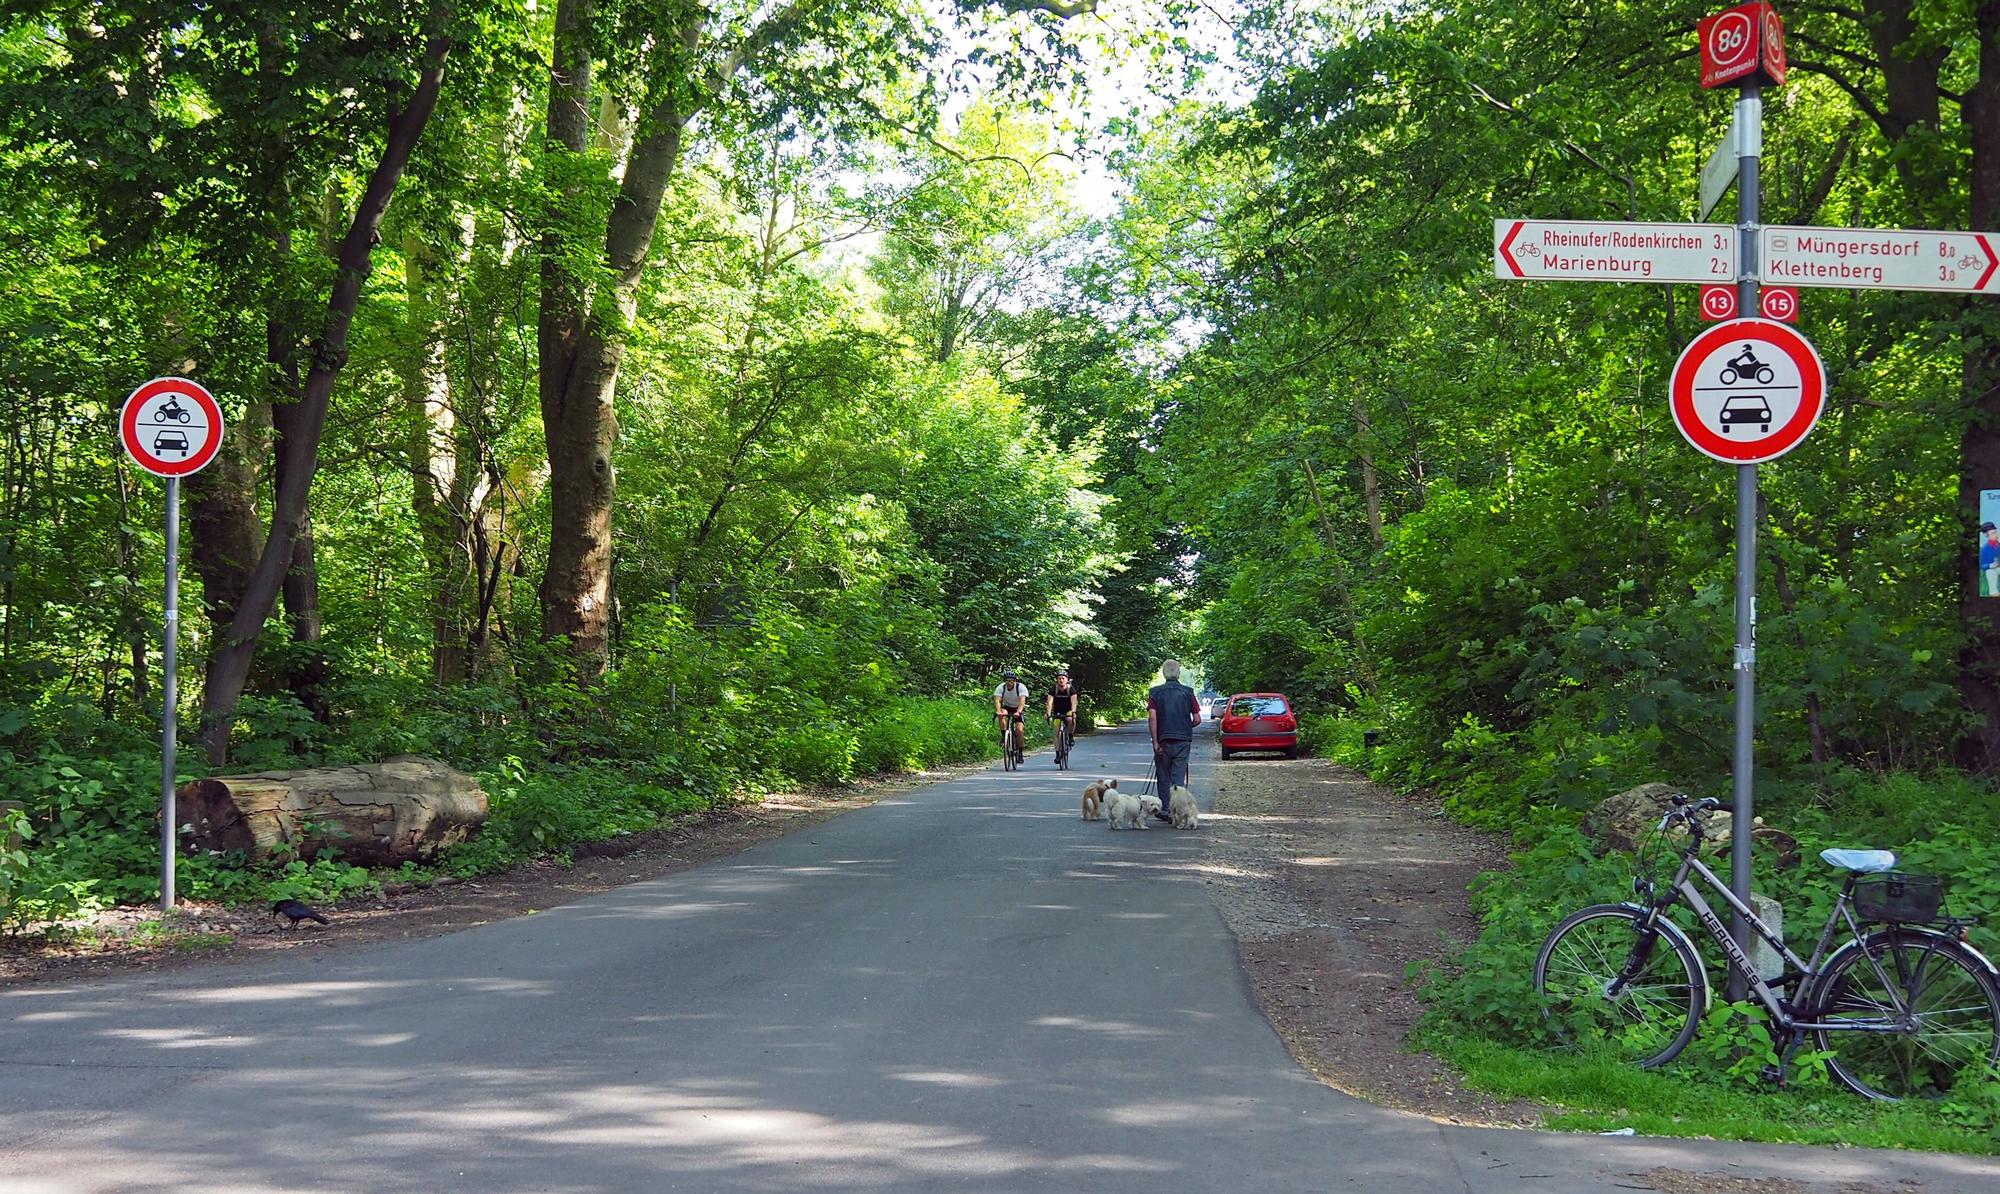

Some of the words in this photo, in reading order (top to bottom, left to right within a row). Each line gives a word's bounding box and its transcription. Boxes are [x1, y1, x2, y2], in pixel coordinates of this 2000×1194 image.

[1718, 24, 1742, 53] 86
[1543, 230, 1702, 250] Rheinufer/Rodenkirchen
[1797, 236, 1920, 258] Müngersdorf
[1543, 254, 1652, 276] Marienburg
[1771, 260, 1883, 283] Klettenberg
[1708, 296, 1728, 309] 13
[1769, 298, 1789, 311] 15
[1702, 911, 1761, 986] HERCULES
